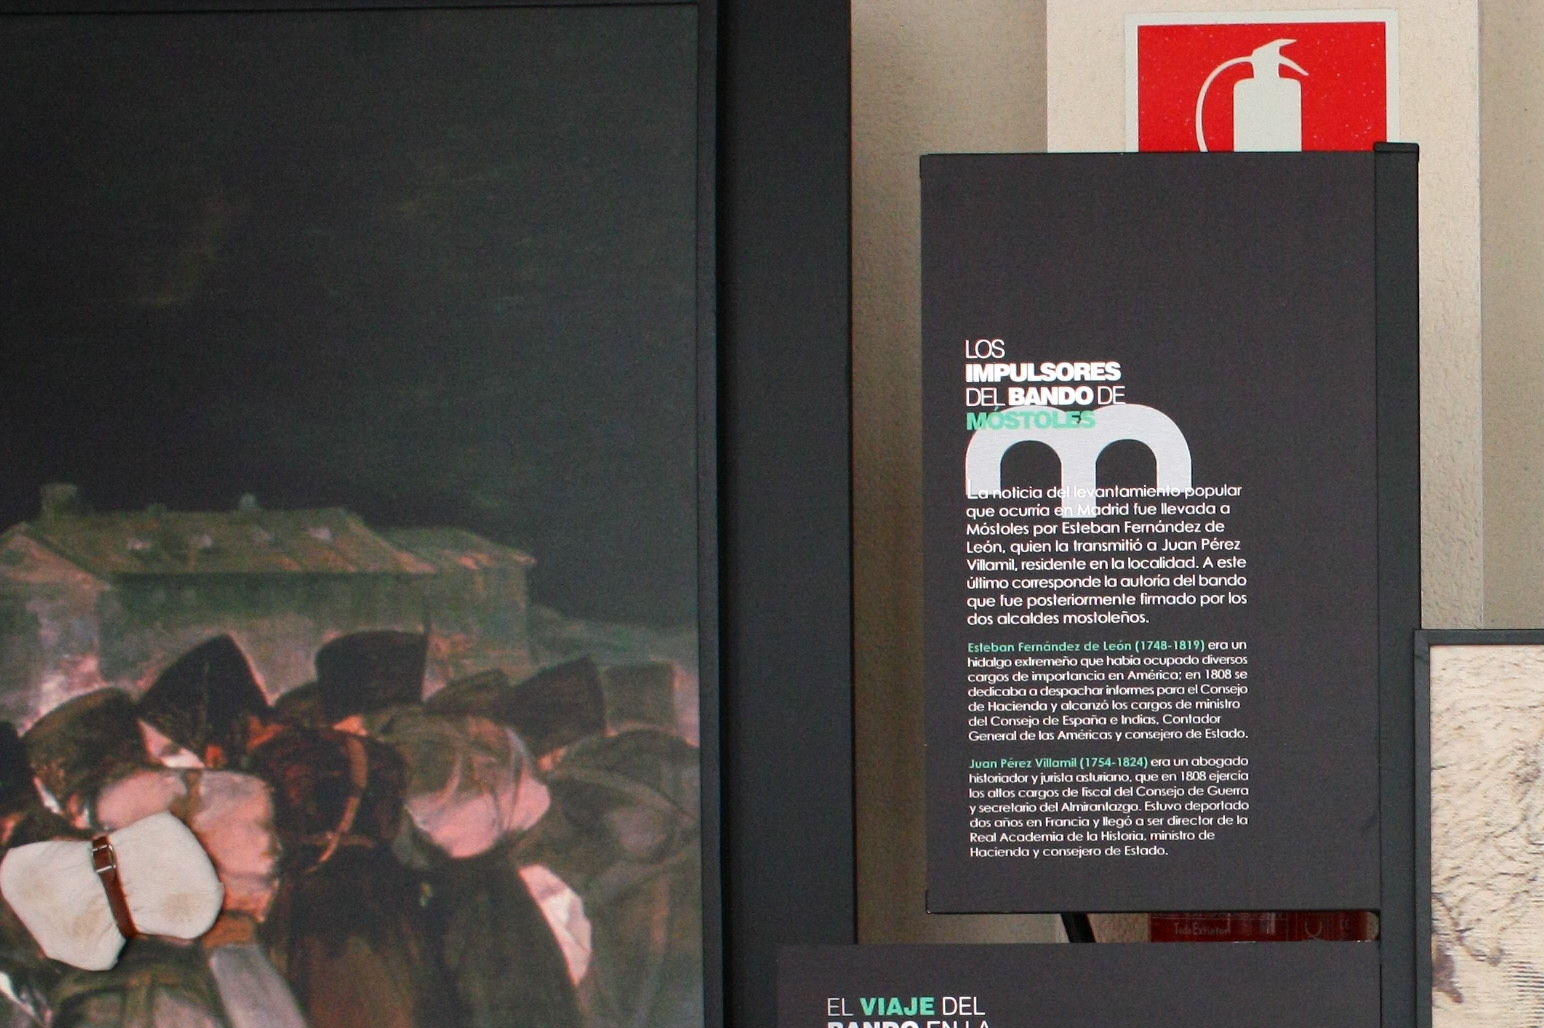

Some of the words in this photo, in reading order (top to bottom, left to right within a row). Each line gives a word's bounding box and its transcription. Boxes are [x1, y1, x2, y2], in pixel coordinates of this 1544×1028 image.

[966, 339, 1004, 358] LOS
[966, 362, 1121, 382] IMPULSORES
[966, 387, 1005, 407] DEL
[1008, 386, 1093, 407] BANDO
[1098, 386, 1125, 405] DE
[966, 406, 1096, 430] MÓSTOLES
[966, 522, 1028, 535] Móstoles
[1033, 525, 1058, 536] por
[1062, 521, 1119, 533] Esteban
[1124, 520, 1200, 533] Fernández
[1204, 520, 1224, 532] de
[966, 540, 1005, 553] León,
[1010, 540, 1050, 555] quien
[1055, 540, 1068, 552] la
[1073, 538, 1142, 551] transmitió
[1146, 541, 1156, 551] a
[1162, 539, 1196, 551] Juan
[1201, 537, 1240, 550] Pérez
[966, 558, 1017, 571] Villamil,
[1021, 558, 1086, 570] residente
[1089, 560, 1108, 569] en
[1111, 557, 1124, 569] la
[1128, 556, 1198, 569] localidad.
[1202, 557, 1213, 568] A
[1217, 556, 1246, 568] este
[967, 577, 1008, 589] último
[1012, 576, 1100, 589] corresponde
[1104, 575, 1116, 587] la
[1120, 574, 1169, 587] autoría
[1173, 574, 1195, 586] del
[1198, 574, 1246, 586] bando
[967, 597, 995, 609] que
[1000, 594, 1022, 606] fue
[1027, 594, 1135, 608] posteriormente
[1140, 592, 1196, 604] firmado
[1200, 594, 1224, 606] por
[1228, 592, 1246, 604] los
[967, 613, 992, 625] dos
[997, 612, 1058, 624] alcaldes
[1063, 611, 1148, 623] mostoleños.
[968, 643, 1014, 652] Esteban
[1018, 642, 1079, 651] Fernández
[1084, 641, 1099, 651] de
[1103, 640, 1131, 650] León
[1135, 640, 1204, 652] (1748-1819)
[1208, 642, 1228, 650] era
[1231, 641, 1246, 649] un
[970, 760, 996, 768] Juan
[1001, 758, 1031, 768] Pérez
[1035, 758, 1076, 767] Villamil
[1080, 757, 1147, 769] (1754-1824)
[1173, 758, 1188, 766] un
[1191, 756, 1248, 768] abogado
[828, 998, 853, 1016] EL
[860, 997, 934, 1015] VIAJE
[942, 996, 985, 1015] DEL
